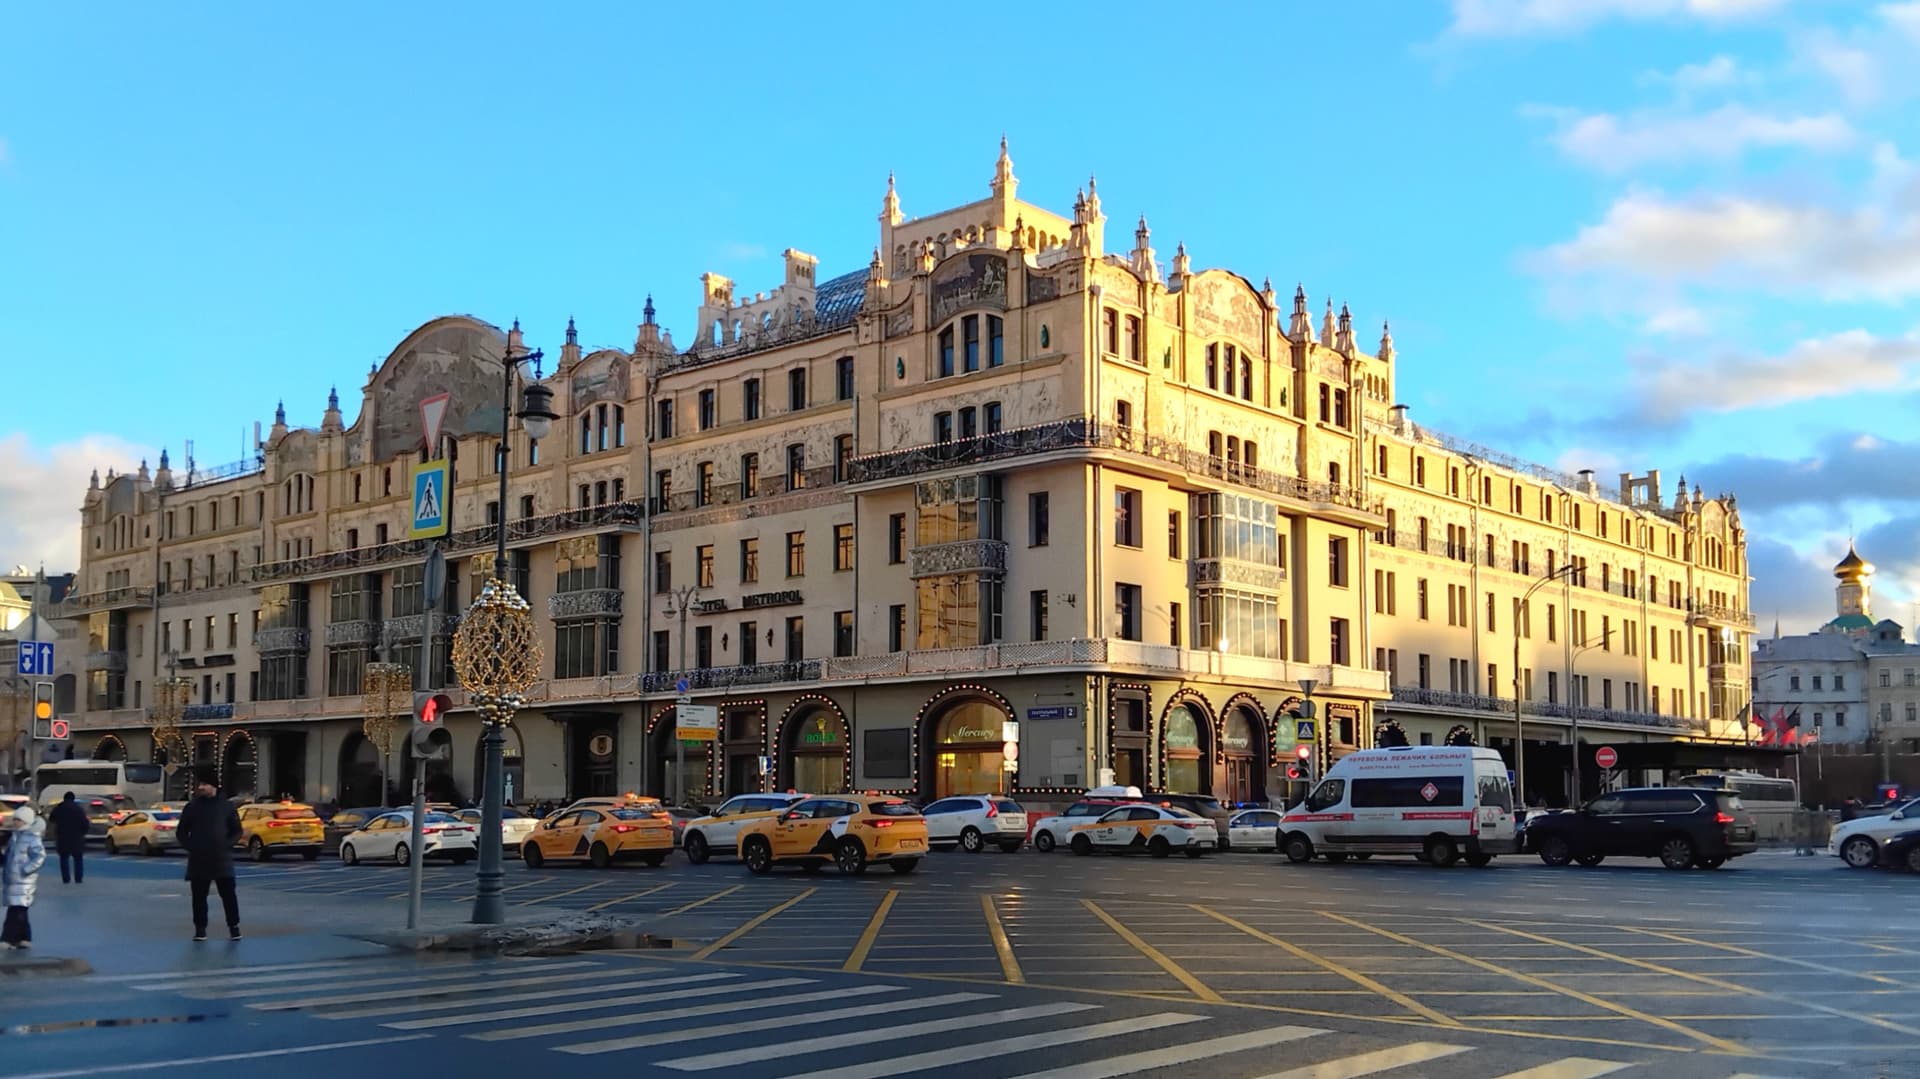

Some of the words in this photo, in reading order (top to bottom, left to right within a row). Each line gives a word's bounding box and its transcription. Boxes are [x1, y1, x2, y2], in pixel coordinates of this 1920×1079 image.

[742, 589, 803, 608] METROPOL
[953, 725, 994, 740] Mercury
[1391, 753, 1426, 762] ЛЕЖАЧИХ
